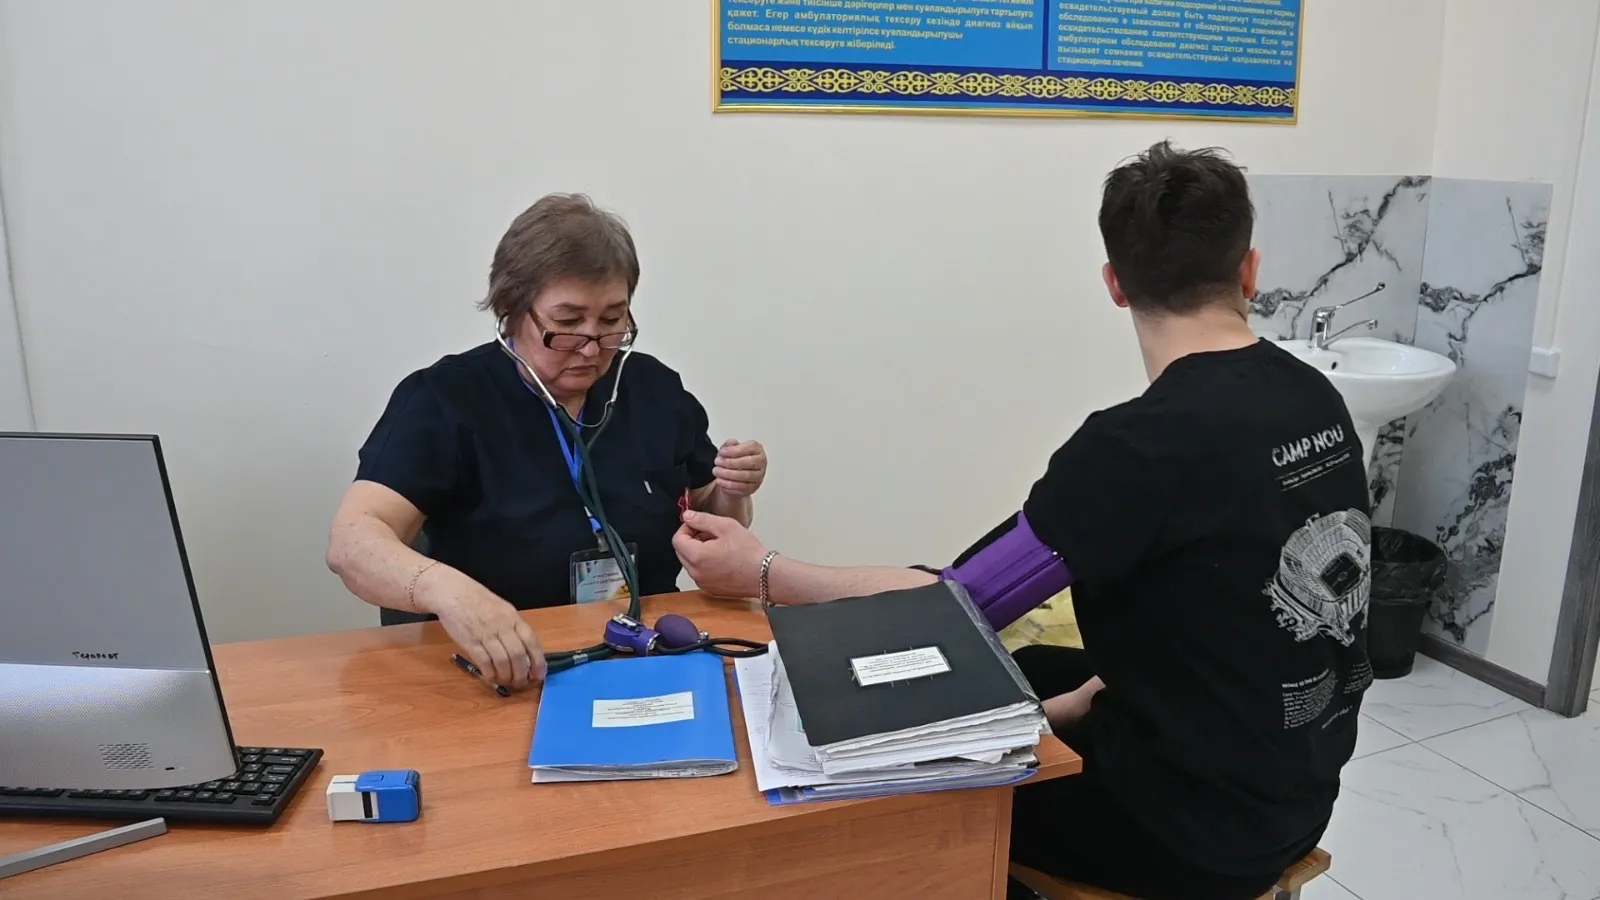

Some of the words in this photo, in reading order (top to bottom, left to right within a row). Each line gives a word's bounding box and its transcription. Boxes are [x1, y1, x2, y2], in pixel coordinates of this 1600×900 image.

[765, 9, 788, 20] Егер
[885, 15, 921, 26] тексеру
[965, 19, 1001, 28] диагноз
[1058, 12, 1119, 23] обследованию
[1132, 18, 1180, 28] зависимости
[1195, 21, 1247, 33] обнаруженных
[1059, 3, 1148, 15] освидетельствуемый
[1151, 9, 1180, 18] должен
[1184, 10, 1204, 20] быть
[1207, 13, 1249, 24] подвергнут
[1252, 17, 1295, 28] подробному
[727, 21, 770, 31] болмаса
[771, 24, 806, 33] немесе
[1058, 24, 1149, 36] освидетельствованию
[1152, 30, 1223, 42] соответствующими
[1261, 36, 1278, 45] Если
[800, 38, 845, 48] тексеруге
[1058, 34, 1118, 45] амбулаторном
[1179, 42, 1209, 51] диагноз
[1212, 45, 1243, 53] остается
[1057, 46, 1100, 54] вызывает
[1104, 48, 1144, 57] сомнения
[1147, 51, 1228, 62] освидетельствуемый
[1057, 56, 1111, 67] стационарное
[1271, 437, 1312, 467] CAMP
[1311, 424, 1344, 453] NOU
